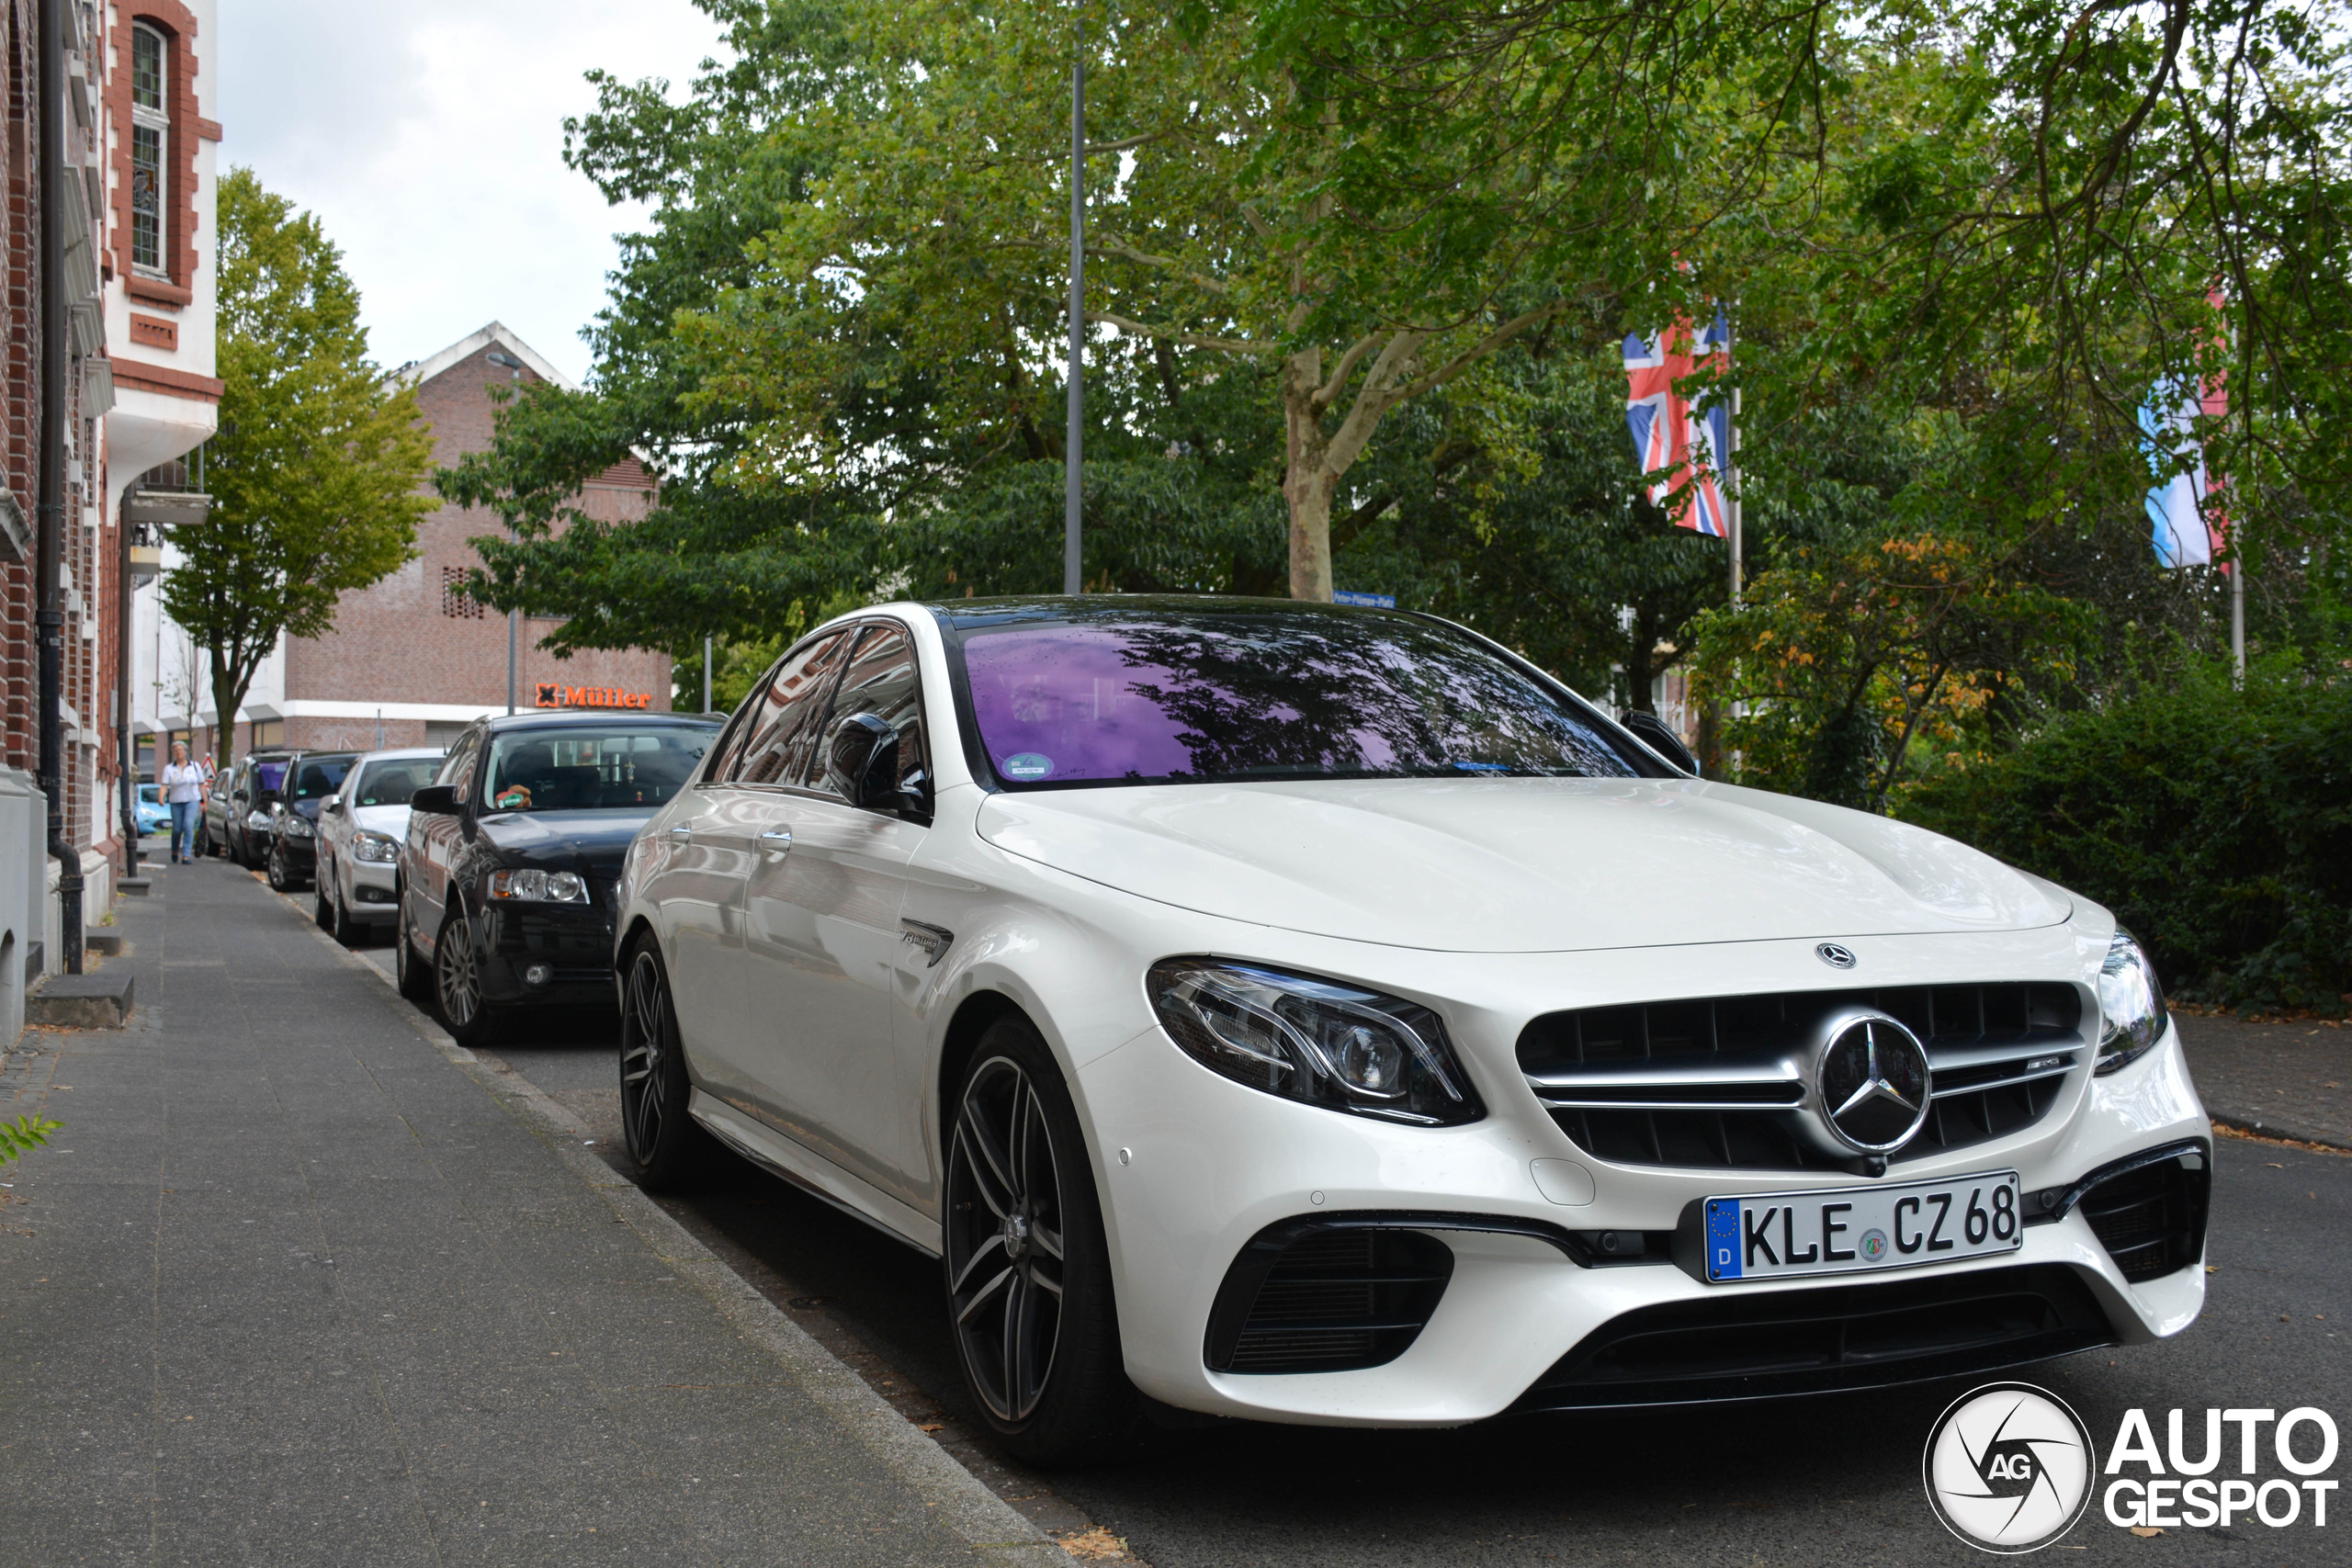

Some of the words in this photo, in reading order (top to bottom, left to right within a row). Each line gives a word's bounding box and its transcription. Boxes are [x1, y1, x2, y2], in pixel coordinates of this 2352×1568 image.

[564, 686, 651, 708] Müller
[1022, 756, 1035, 767] 4
[1745, 1201, 1856, 1267] KLE
[1894, 1192, 1954, 1255] CZ
[1964, 1184, 2017, 1246] 68
[1718, 1248, 1732, 1266] D
